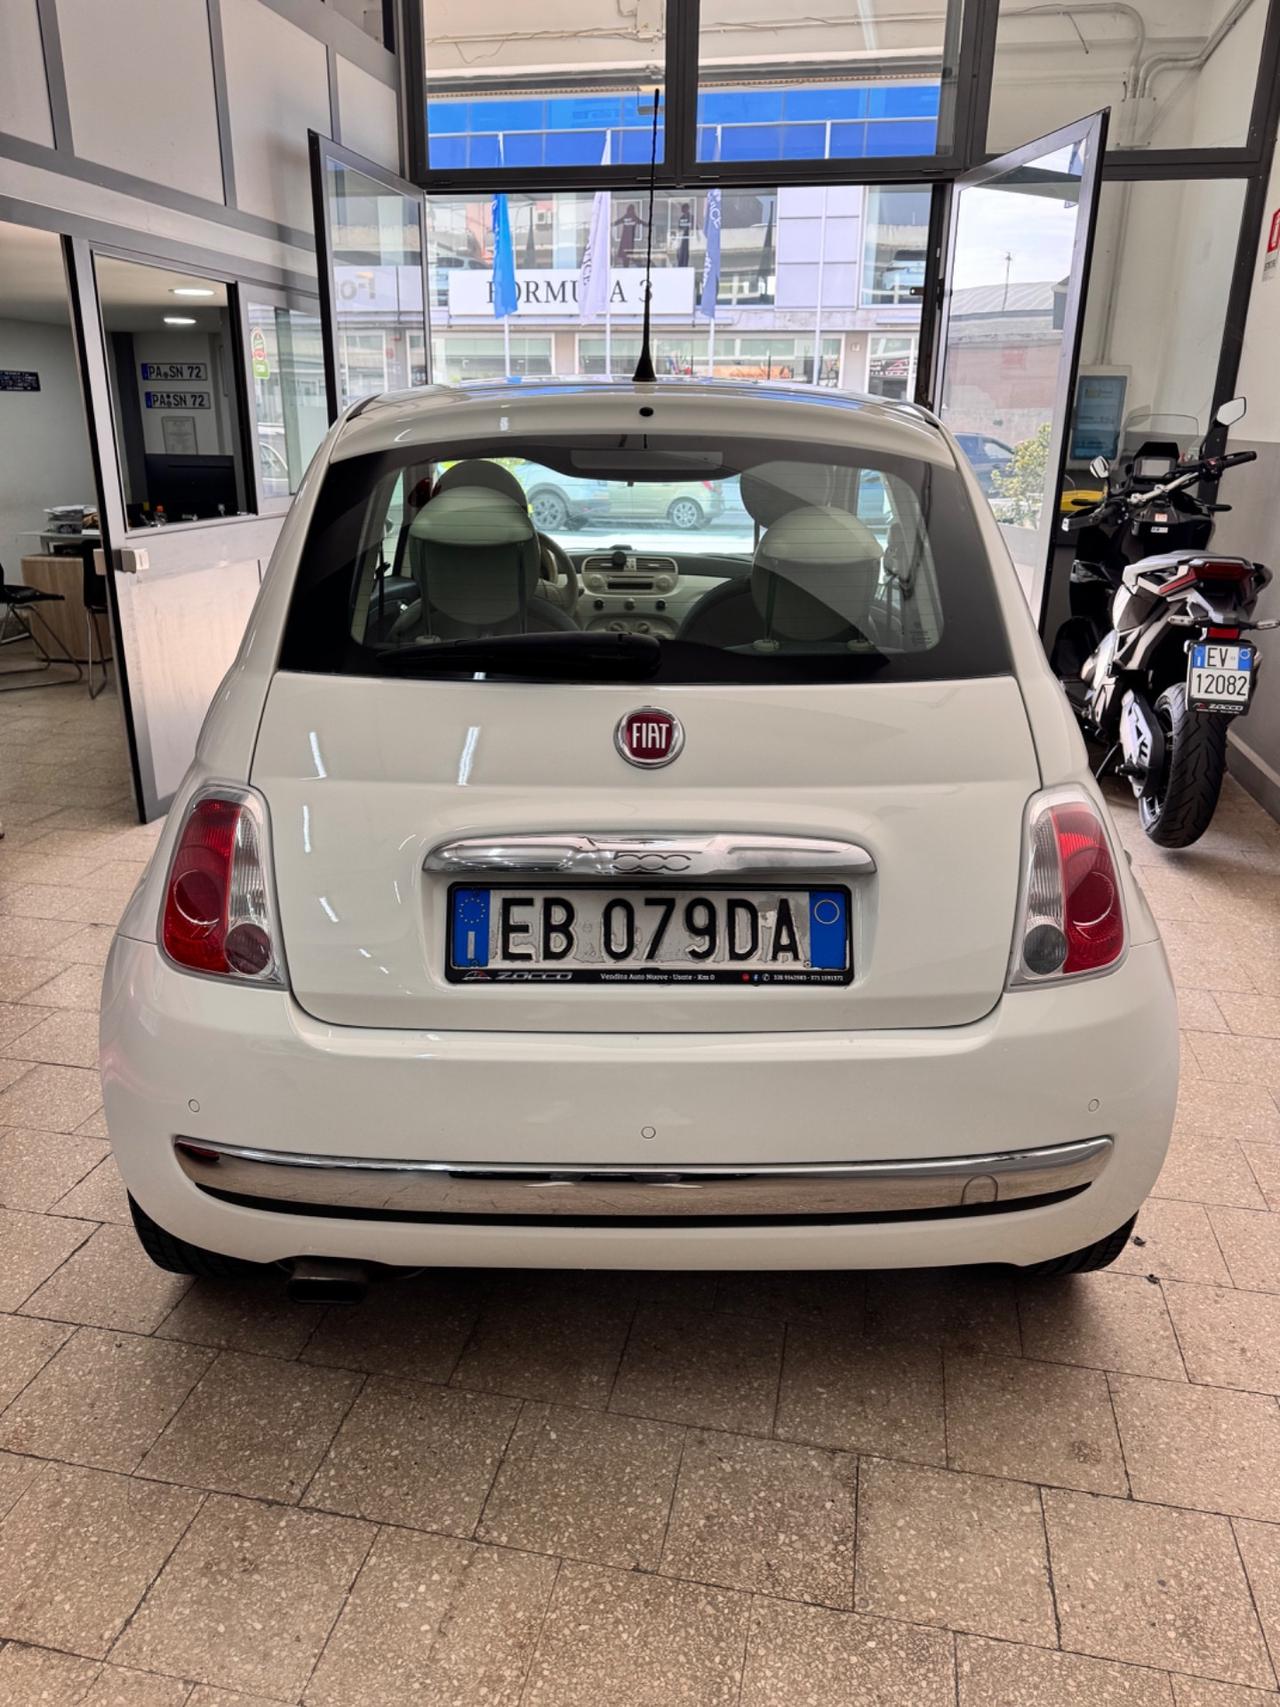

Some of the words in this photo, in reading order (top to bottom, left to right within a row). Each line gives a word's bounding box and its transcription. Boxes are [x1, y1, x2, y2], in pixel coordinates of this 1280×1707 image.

[486, 280, 628, 303] FRMUA
[638, 279, 653, 303] 3
[188, 366, 202, 378] 72
[191, 395, 205, 407] 72
[1207, 647, 1228, 667] EV
[1196, 673, 1247, 696] 12082
[1209, 703, 1244, 711] ZOCCO
[632, 723, 670, 749] FIAT
[613, 851, 698, 872] 500
[501, 897, 575, 962] EB
[496, 971, 573, 980] ZOCCO
